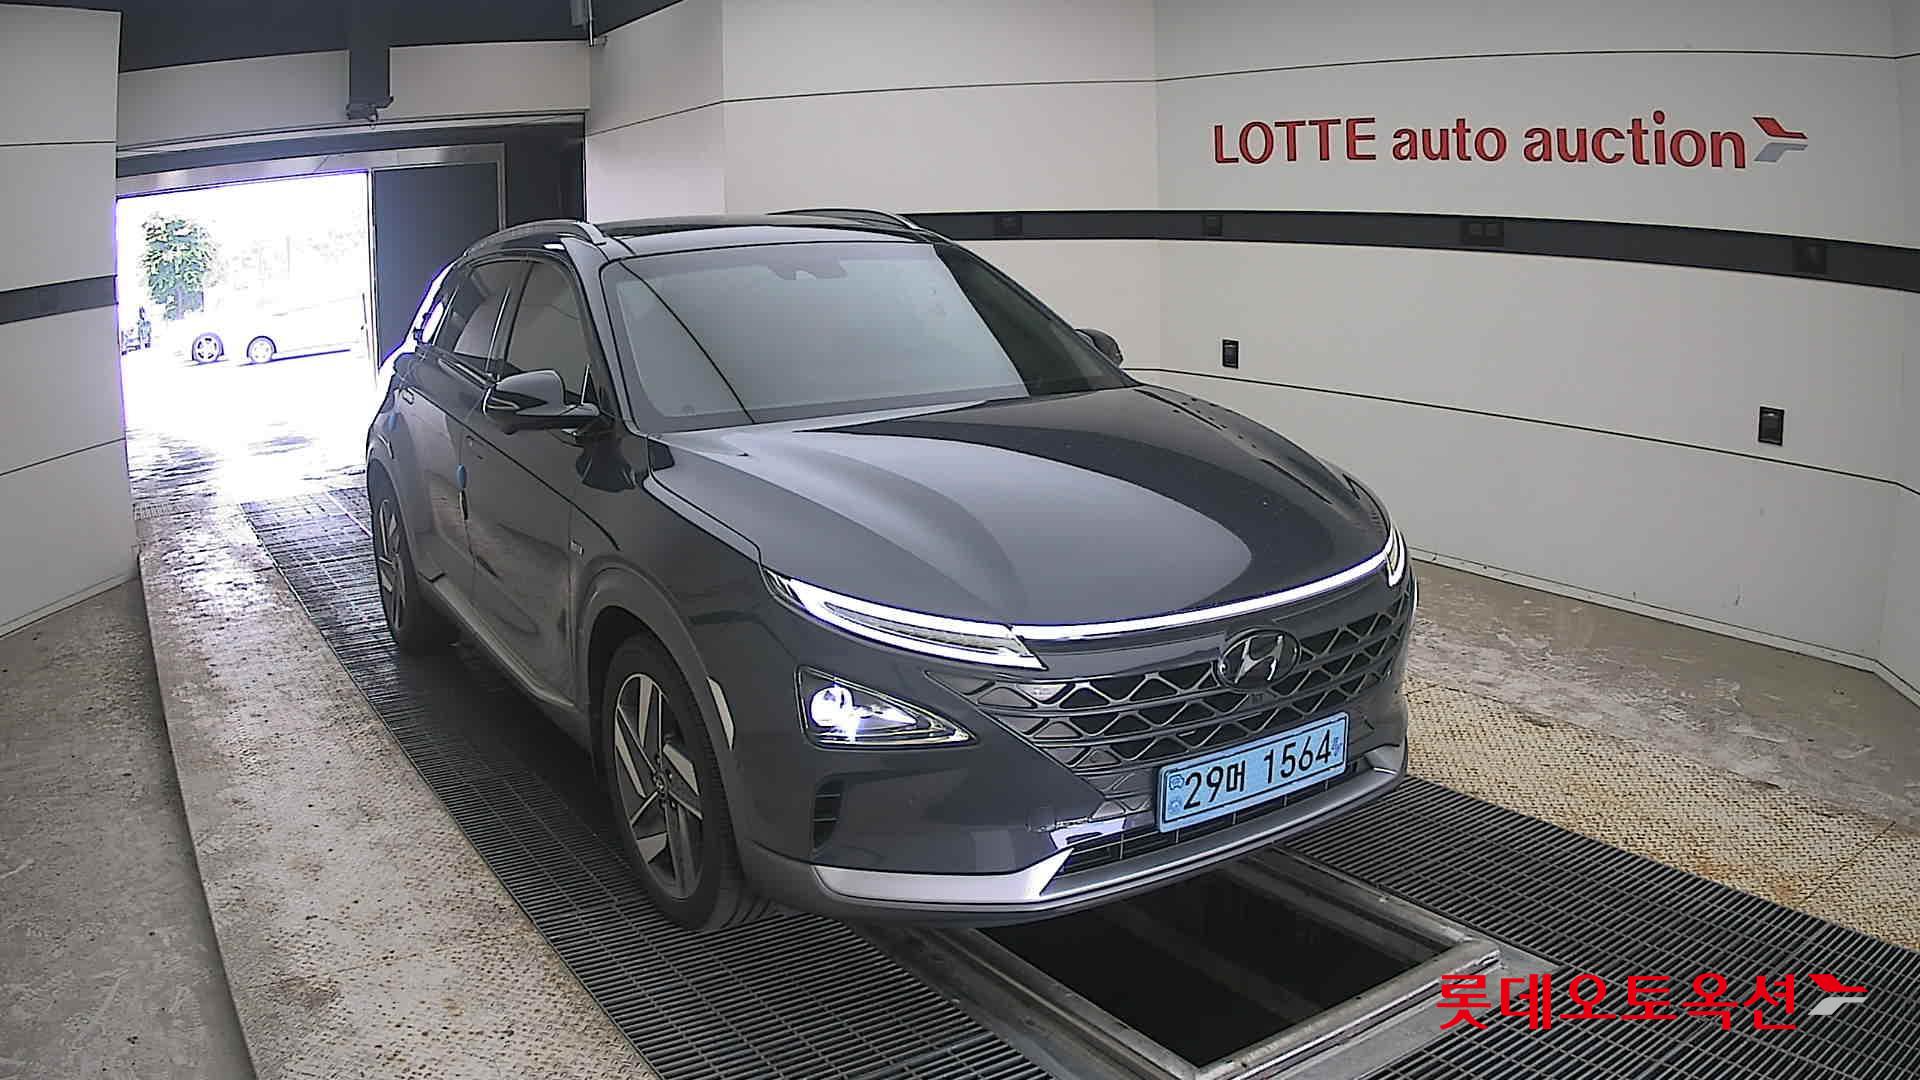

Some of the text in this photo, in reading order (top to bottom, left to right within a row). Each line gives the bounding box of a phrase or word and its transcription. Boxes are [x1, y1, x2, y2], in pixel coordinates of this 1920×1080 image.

[1214, 110, 1748, 168] LOTTE auto auction
[1184, 760, 1246, 810] 29머
[1264, 729, 1331, 784] 1564
